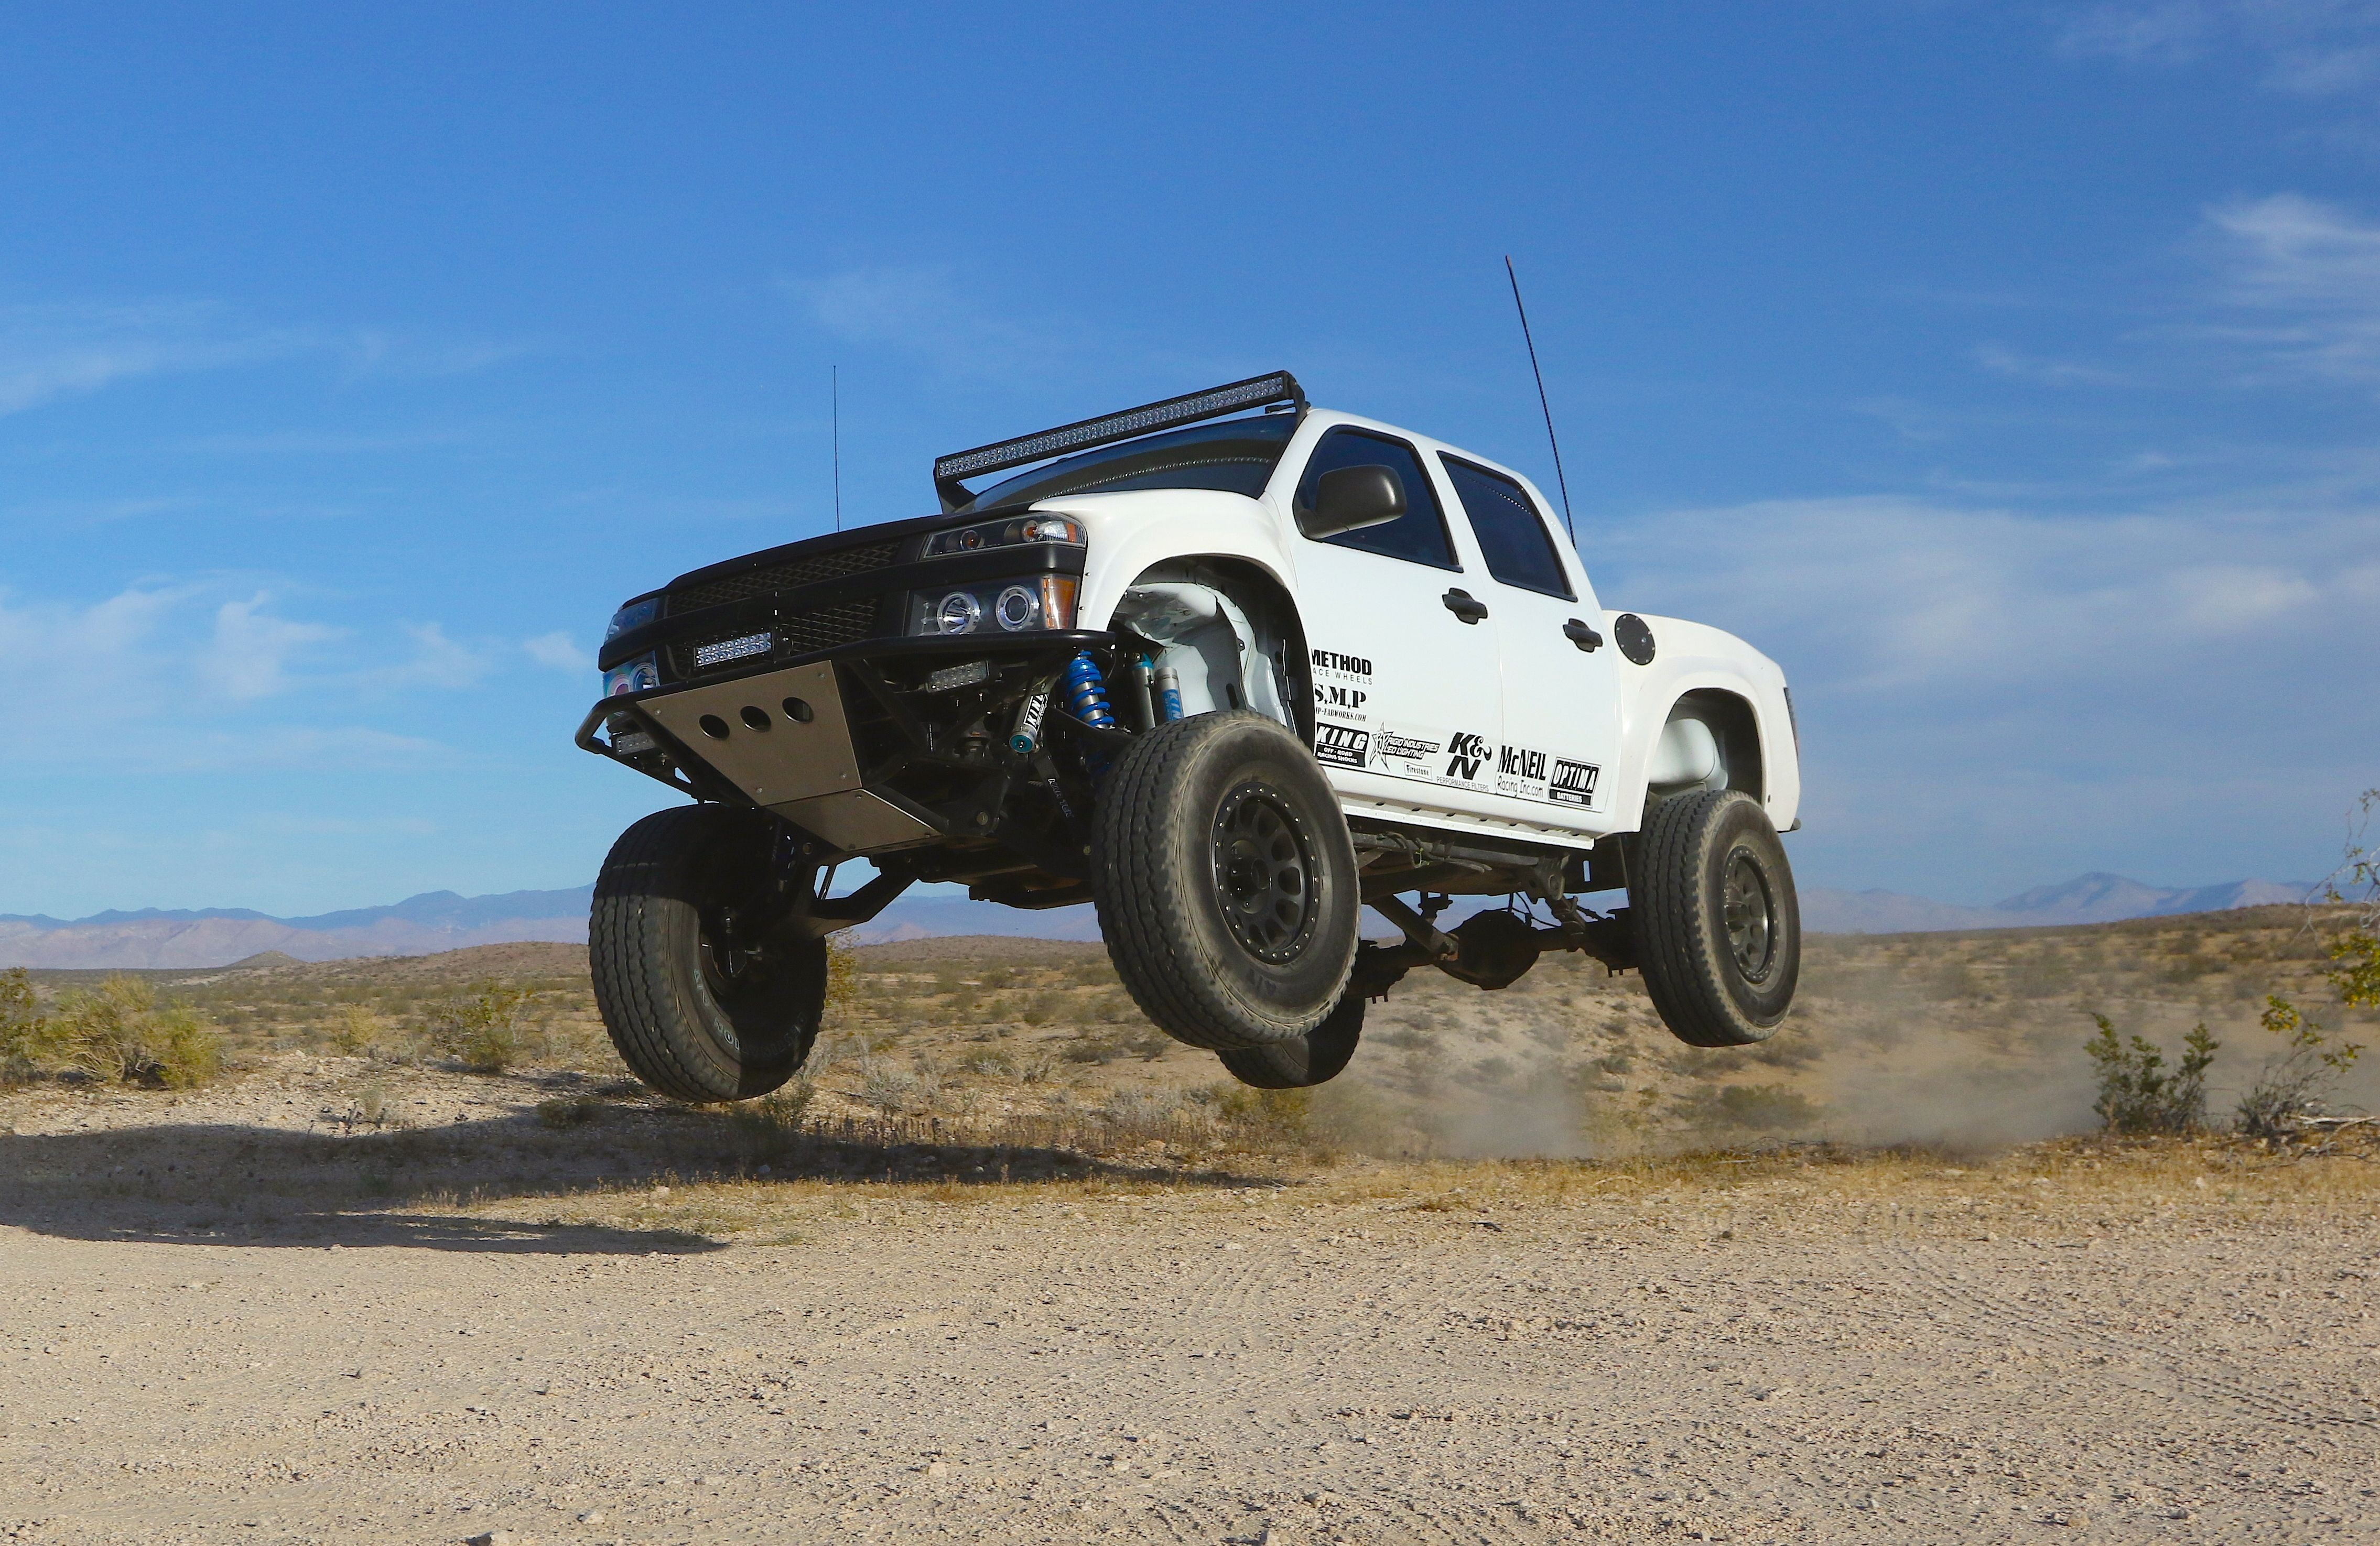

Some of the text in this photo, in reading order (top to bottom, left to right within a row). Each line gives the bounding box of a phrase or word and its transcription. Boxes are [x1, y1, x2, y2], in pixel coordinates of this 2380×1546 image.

[1311, 648, 1372, 676] METHOD
[1313, 668, 1372, 685] ACE WHEELS
[1169, 692, 1182, 719] KIN
[1316, 706, 1367, 722] P-FABWORKS.COM
[1316, 726, 1368, 750] KING
[1403, 738, 1440, 752] INDUSTRIES
[1317, 752, 1337, 760] RACING
[1497, 745, 1546, 781] McNEIL
[1406, 765, 1429, 776] Firestone
[1553, 764, 1596, 791] OPTIMA
[1436, 776, 1489, 792] PERFORMANCE FILTERS
[1497, 776, 1518, 798] Racing
[1556, 791, 1583, 803] BATTERIES
